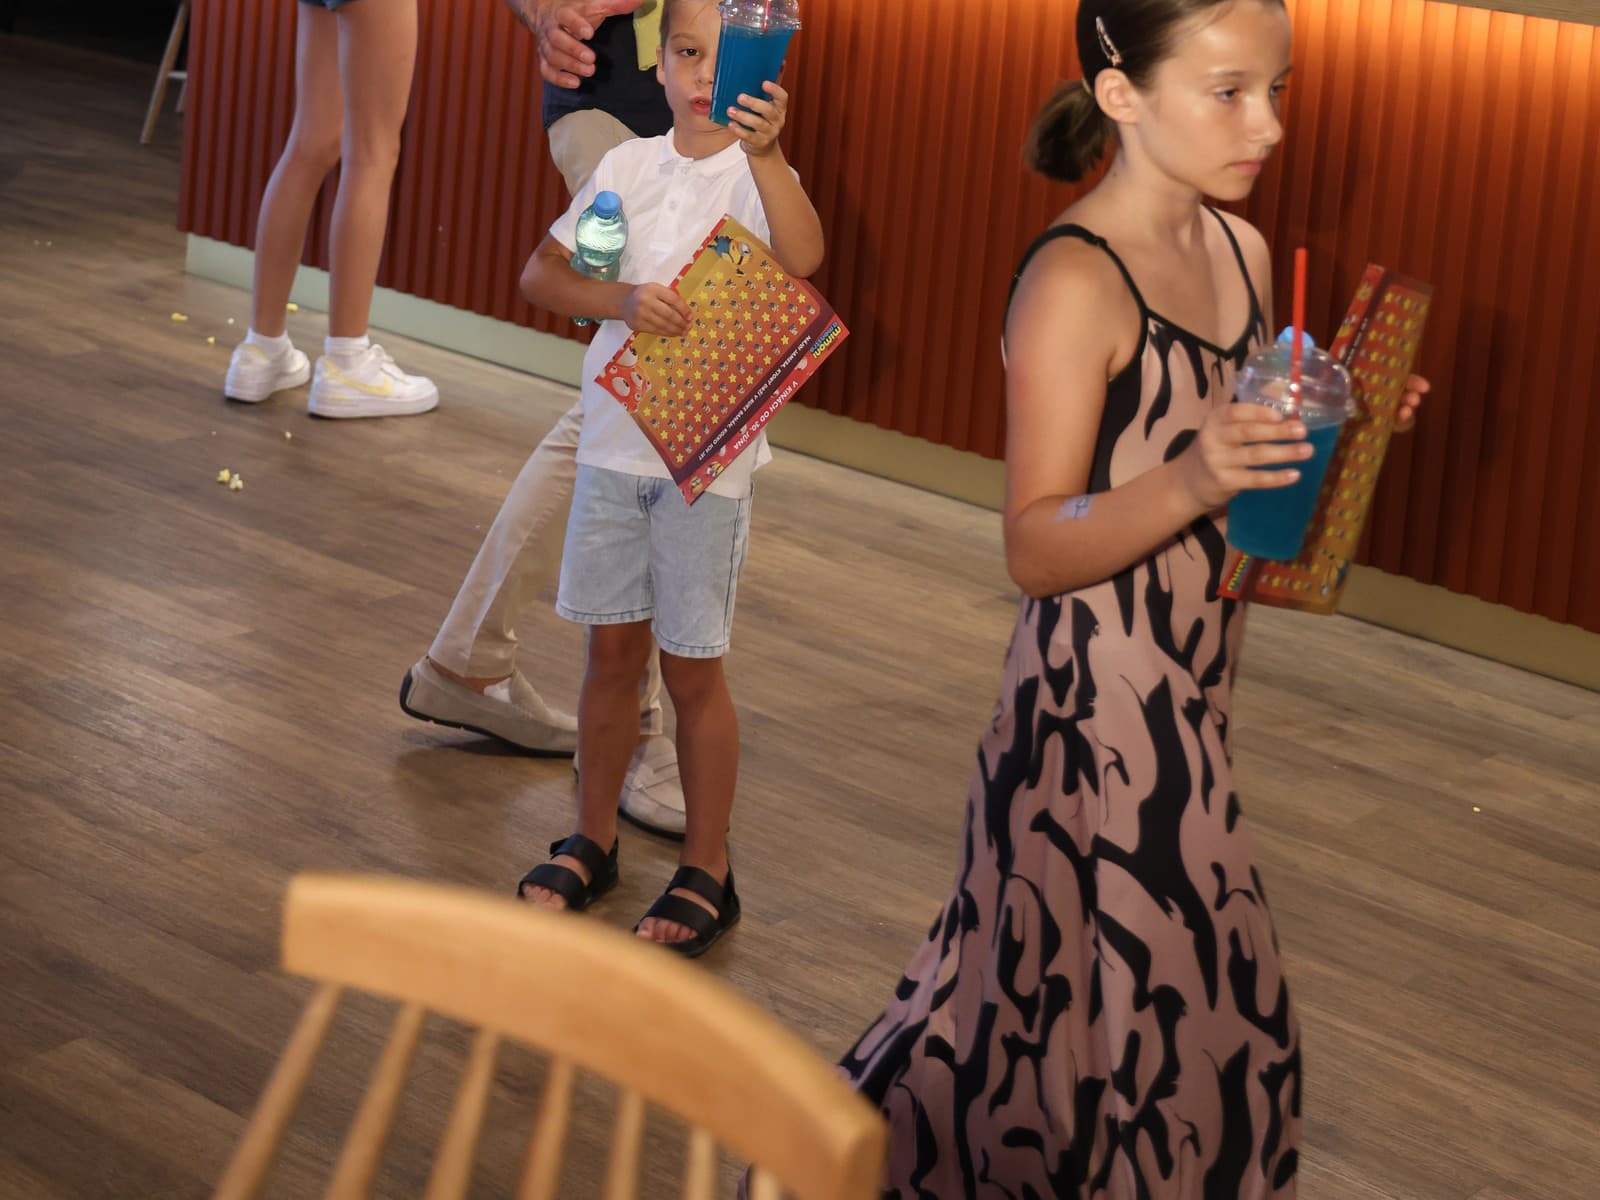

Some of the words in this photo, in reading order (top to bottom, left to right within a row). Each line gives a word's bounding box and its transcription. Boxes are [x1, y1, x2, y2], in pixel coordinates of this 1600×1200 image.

[812, 326, 841, 358] mimoni
[769, 385, 793, 412] KINÁCH
[759, 410, 770, 422] OD
[749, 421, 760, 431] 30.
[733, 431, 750, 450] JÚNA
